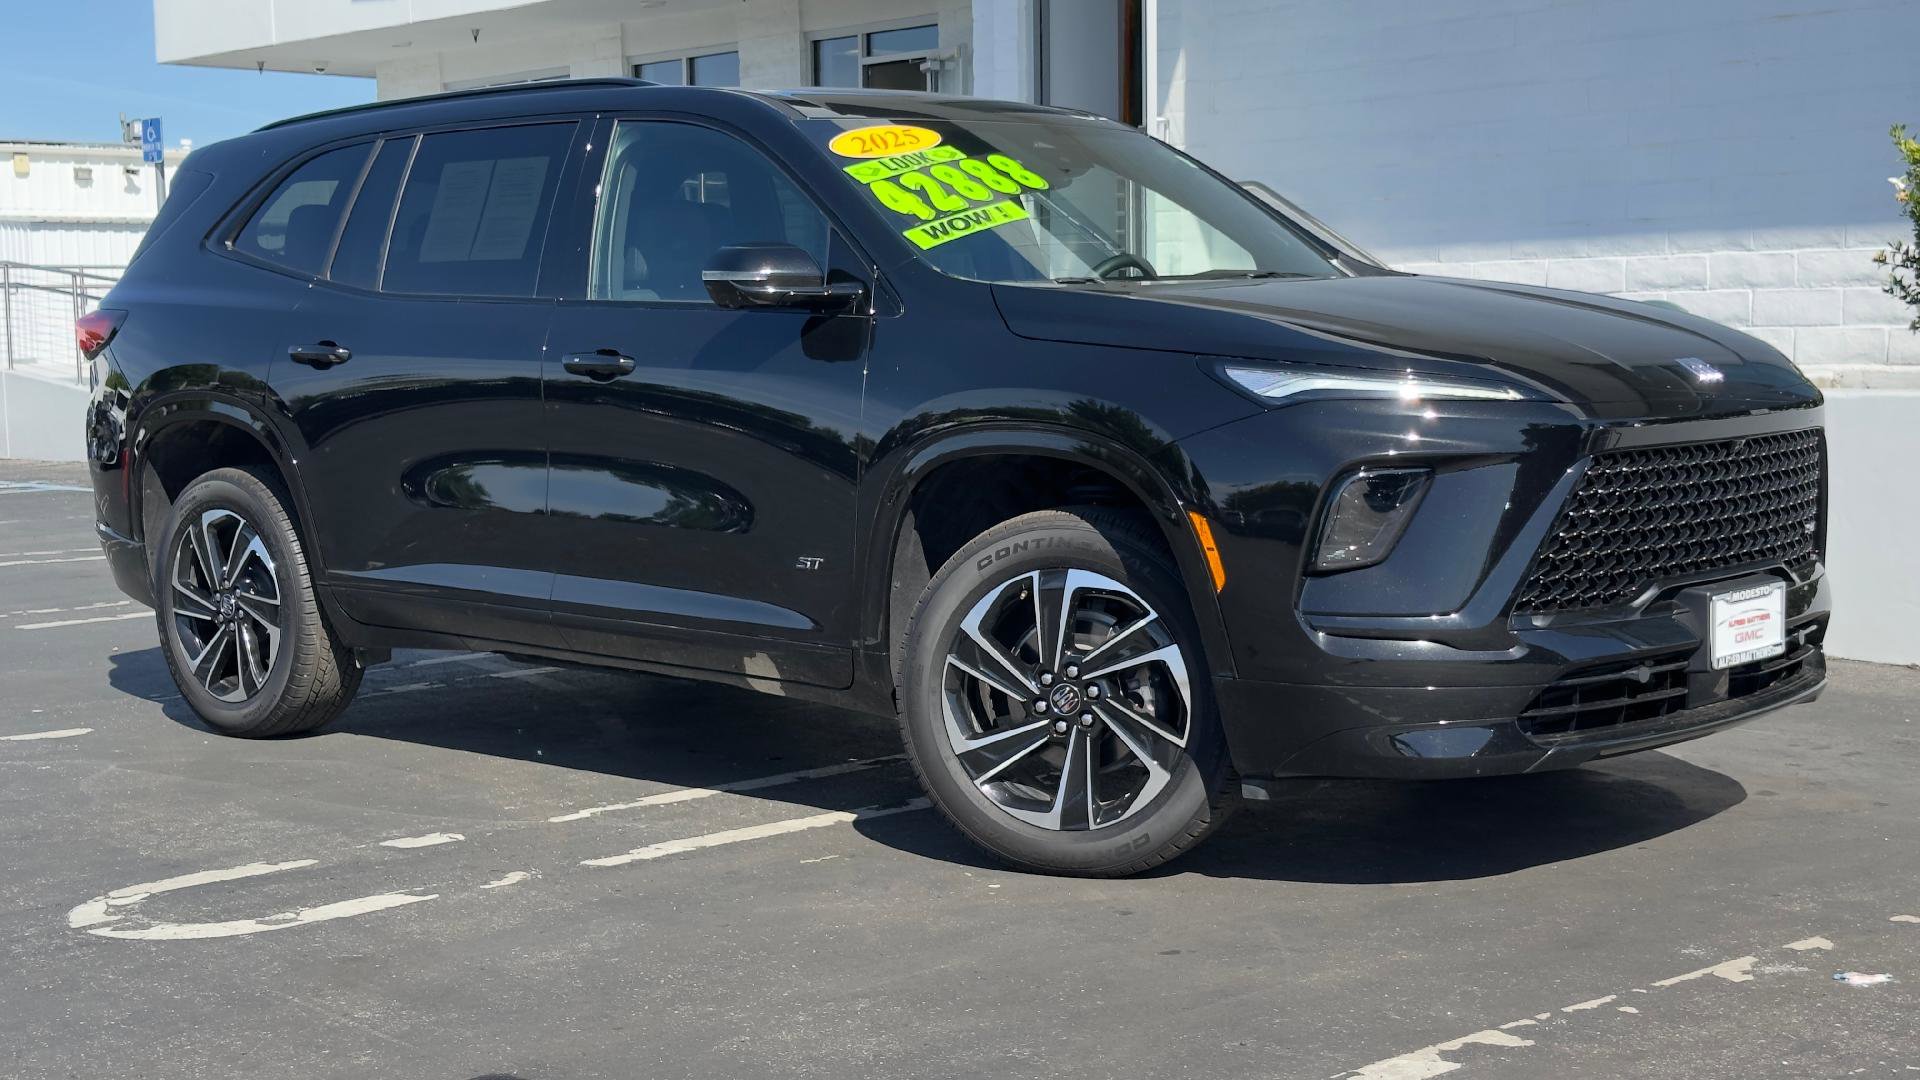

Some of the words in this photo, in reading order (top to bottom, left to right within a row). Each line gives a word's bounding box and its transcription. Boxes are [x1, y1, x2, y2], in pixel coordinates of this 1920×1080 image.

[851, 129, 920, 154] 2025
[879, 151, 934, 171] LOOK
[870, 154, 1049, 220] 42888
[796, 556, 824, 570] ST
[1732, 585, 1770, 600] MODESTO
[1735, 628, 1764, 643] GMC
